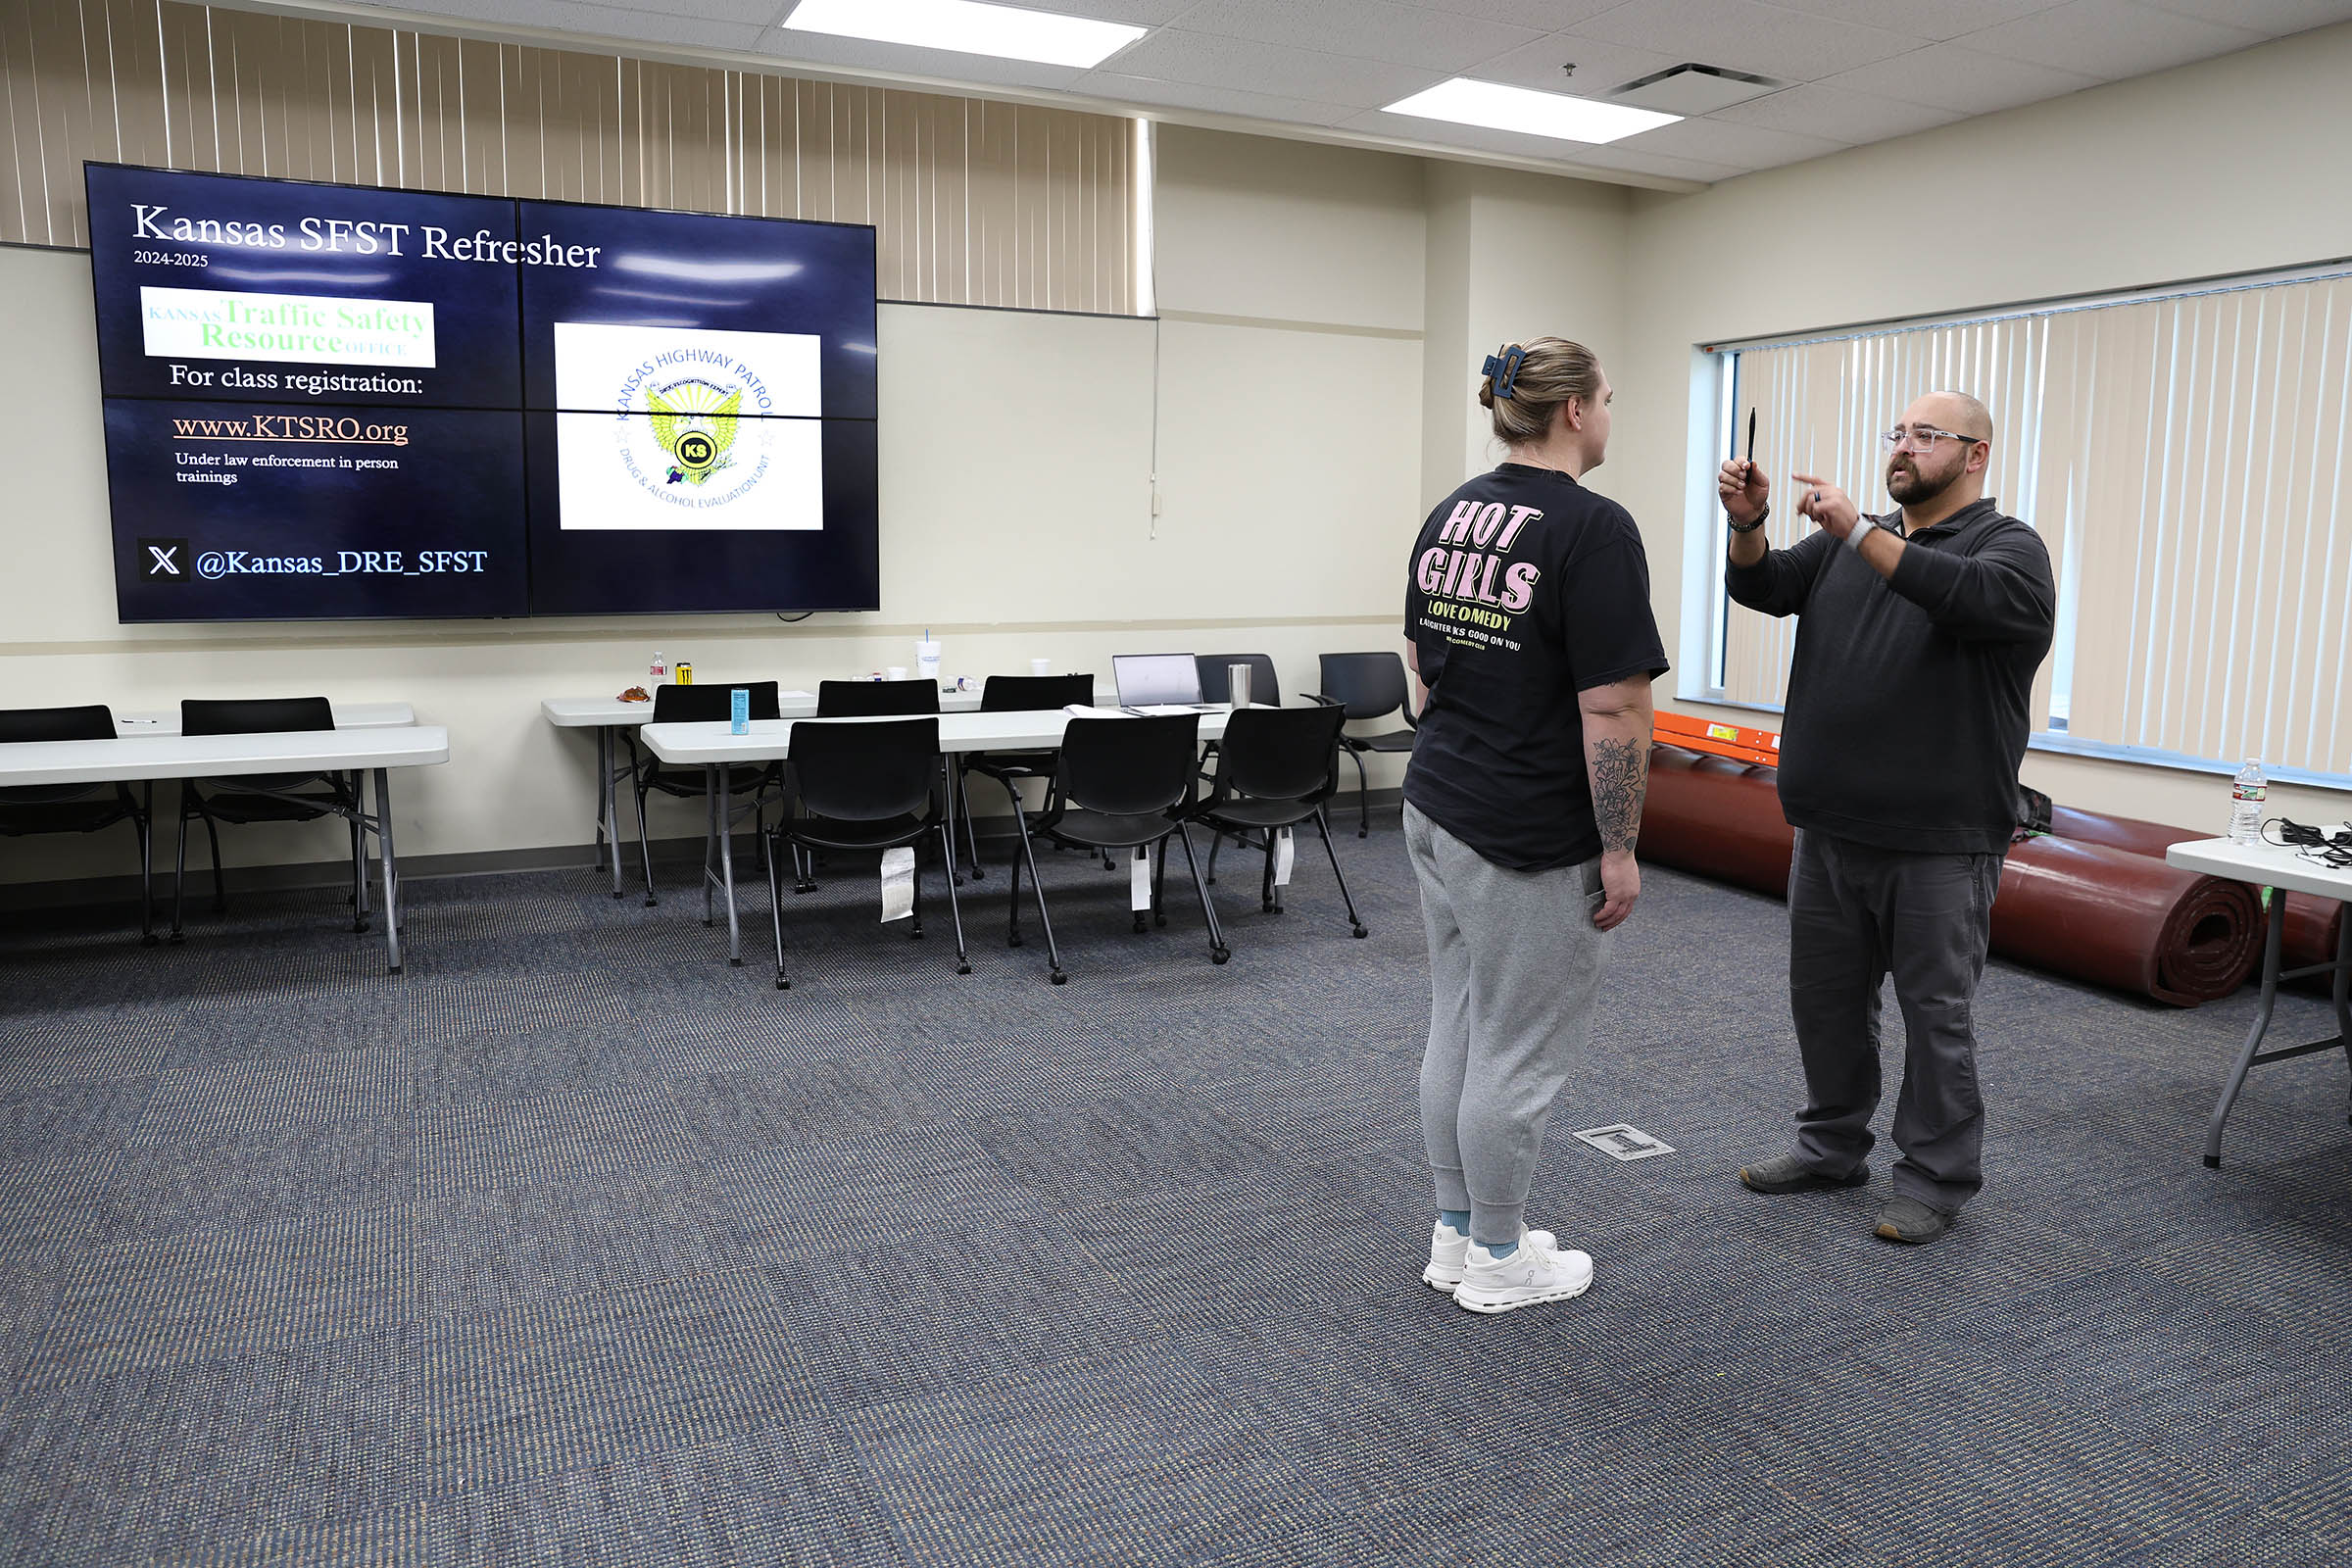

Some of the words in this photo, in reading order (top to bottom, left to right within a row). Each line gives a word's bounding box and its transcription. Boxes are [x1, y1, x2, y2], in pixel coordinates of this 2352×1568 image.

[130, 204, 286, 249] Kansas
[300, 217, 409, 258] SFST
[420, 225, 601, 269] Refresher
[134, 250, 209, 269] 2024-2025
[149, 307, 221, 321] KANSAS
[220, 299, 326, 328] Traffic
[337, 306, 426, 339] Safety
[202, 323, 343, 354] Resource
[345, 341, 408, 356] OFFICE
[170, 365, 215, 386] For
[220, 368, 278, 389] class
[284, 370, 423, 395] registration:
[616, 361, 655, 421] KANSAS
[656, 349, 734, 368] HIGHWAY
[734, 364, 773, 422] PATROL
[172, 415, 409, 446] www.KTSRO.org
[174, 452, 221, 466] Under
[223, 454, 248, 466] law
[252, 455, 336, 468] enforcement
[339, 455, 353, 468] in
[355, 458, 399, 470] person
[685, 444, 708, 458] KS
[176, 470, 238, 485] trainings
[619, 447, 642, 479] DRUG
[638, 477, 648, 487] &
[648, 484, 696, 509] ALCOHOL
[698, 477, 758, 509] EVALUATION
[754, 454, 771, 479] UNIT
[1438, 500, 1544, 553] HOT
[196, 551, 488, 580] @Kansas_DRE_SFST
[1417, 547, 1541, 614] GIRLS
[1428, 599, 1458, 619] LOVE
[1468, 629, 1489, 643] GOOD
[1490, 636, 1503, 647] ON
[1505, 640, 1521, 652] YOU
